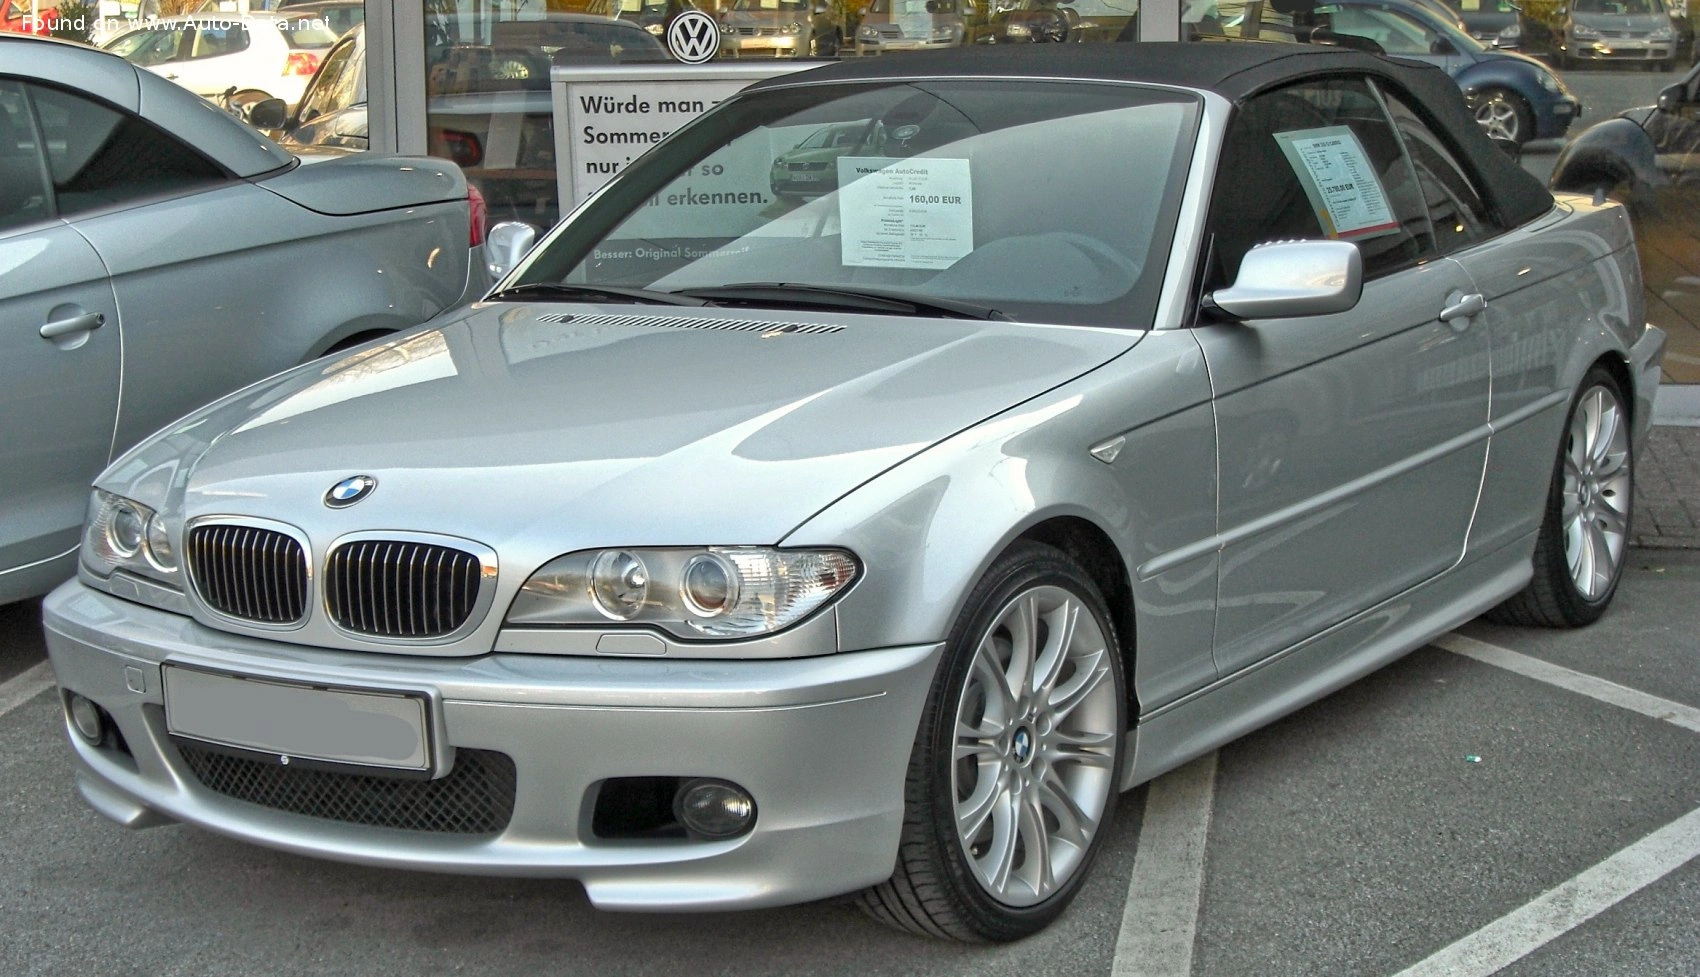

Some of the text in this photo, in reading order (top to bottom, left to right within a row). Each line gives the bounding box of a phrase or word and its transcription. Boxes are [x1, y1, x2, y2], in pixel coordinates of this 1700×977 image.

[580, 94, 704, 114] Würde man
[586, 161, 619, 174] nur
[702, 163, 724, 176] so
[856, 167, 894, 176] Volkswagen
[667, 187, 768, 206] erkennen.
[909, 195, 940, 204] 160,00
[942, 196, 961, 204] EUR
[594, 248, 632, 260] Besser:
[635, 246, 681, 261] Original
